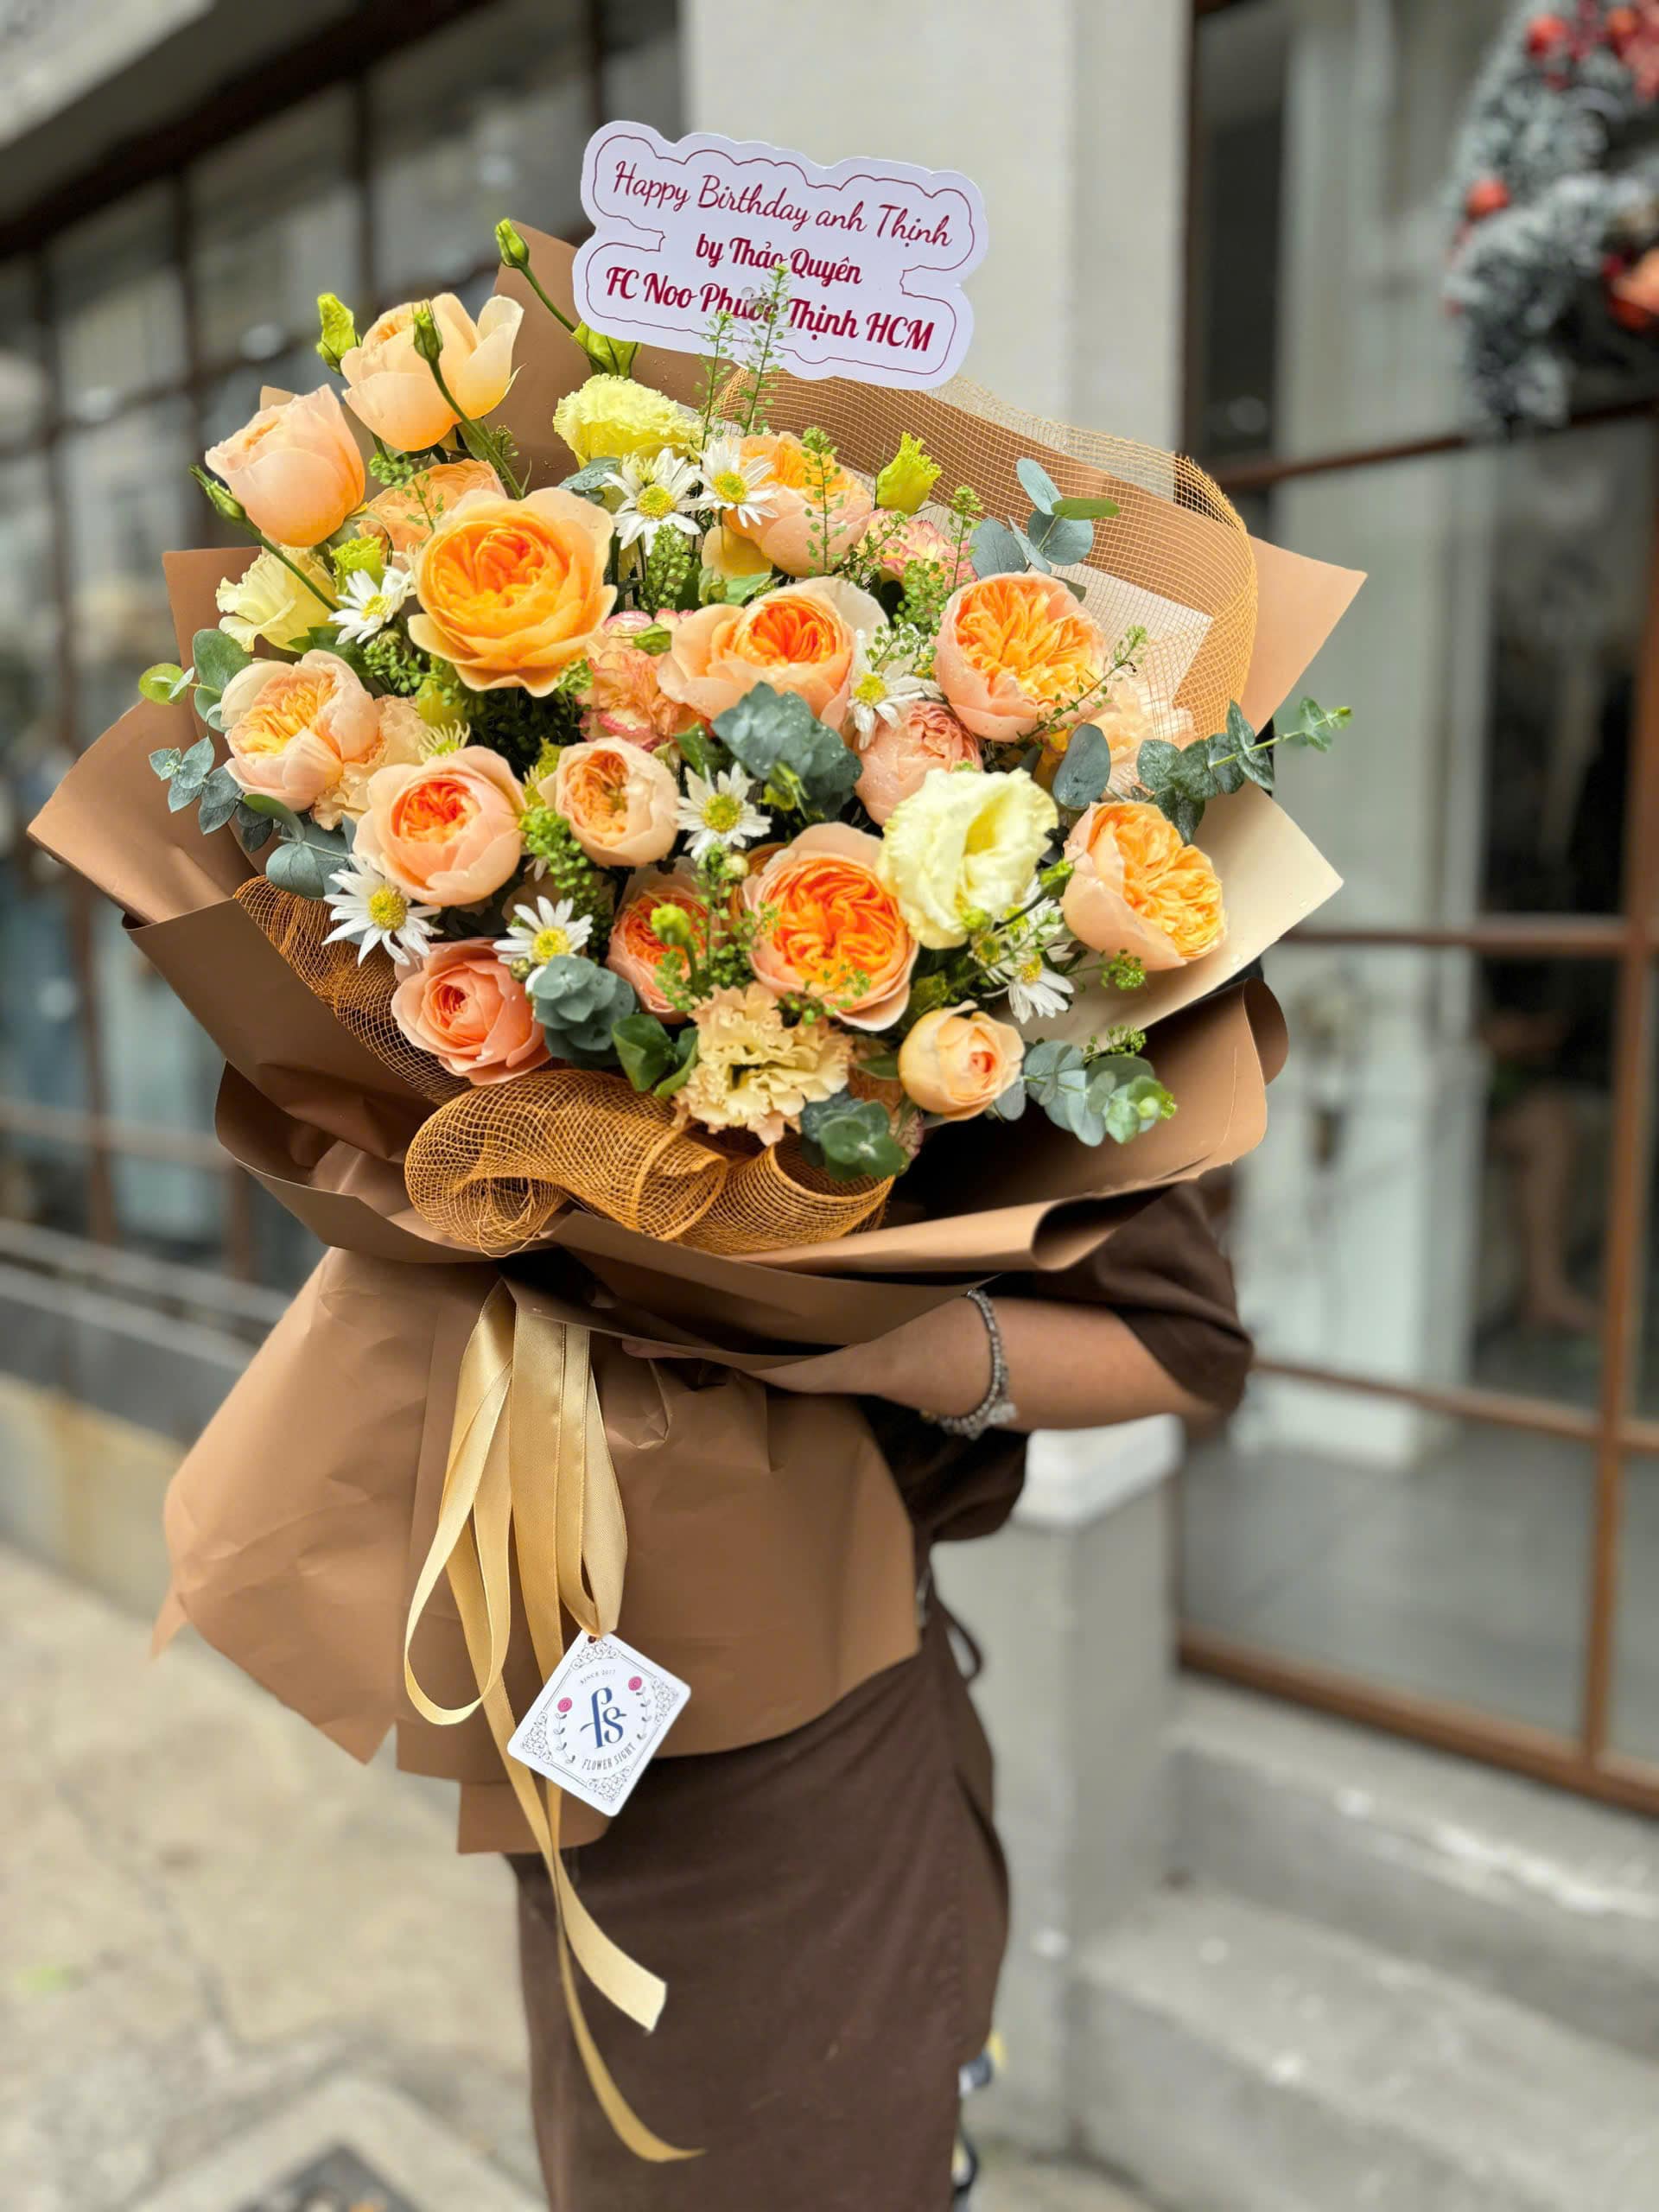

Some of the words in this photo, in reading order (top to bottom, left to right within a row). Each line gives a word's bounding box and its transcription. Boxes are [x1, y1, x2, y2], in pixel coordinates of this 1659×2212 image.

[613, 160, 690, 213] Happy
[698, 175, 811, 232] Birthday
[815, 200, 867, 232] anh
[876, 204, 954, 248] Thịnh
[696, 233, 724, 268] by
[729, 237, 788, 270] Thảo
[790, 247, 863, 288] Quyên
[606, 266, 640, 299] FC
[643, 273, 697, 308] Noo
[787, 298, 860, 341] Thịnh
[865, 312, 935, 352] HCM
[582, 1758, 613, 1770] FLOWER
[613, 1742, 637, 1765] SIGHT
